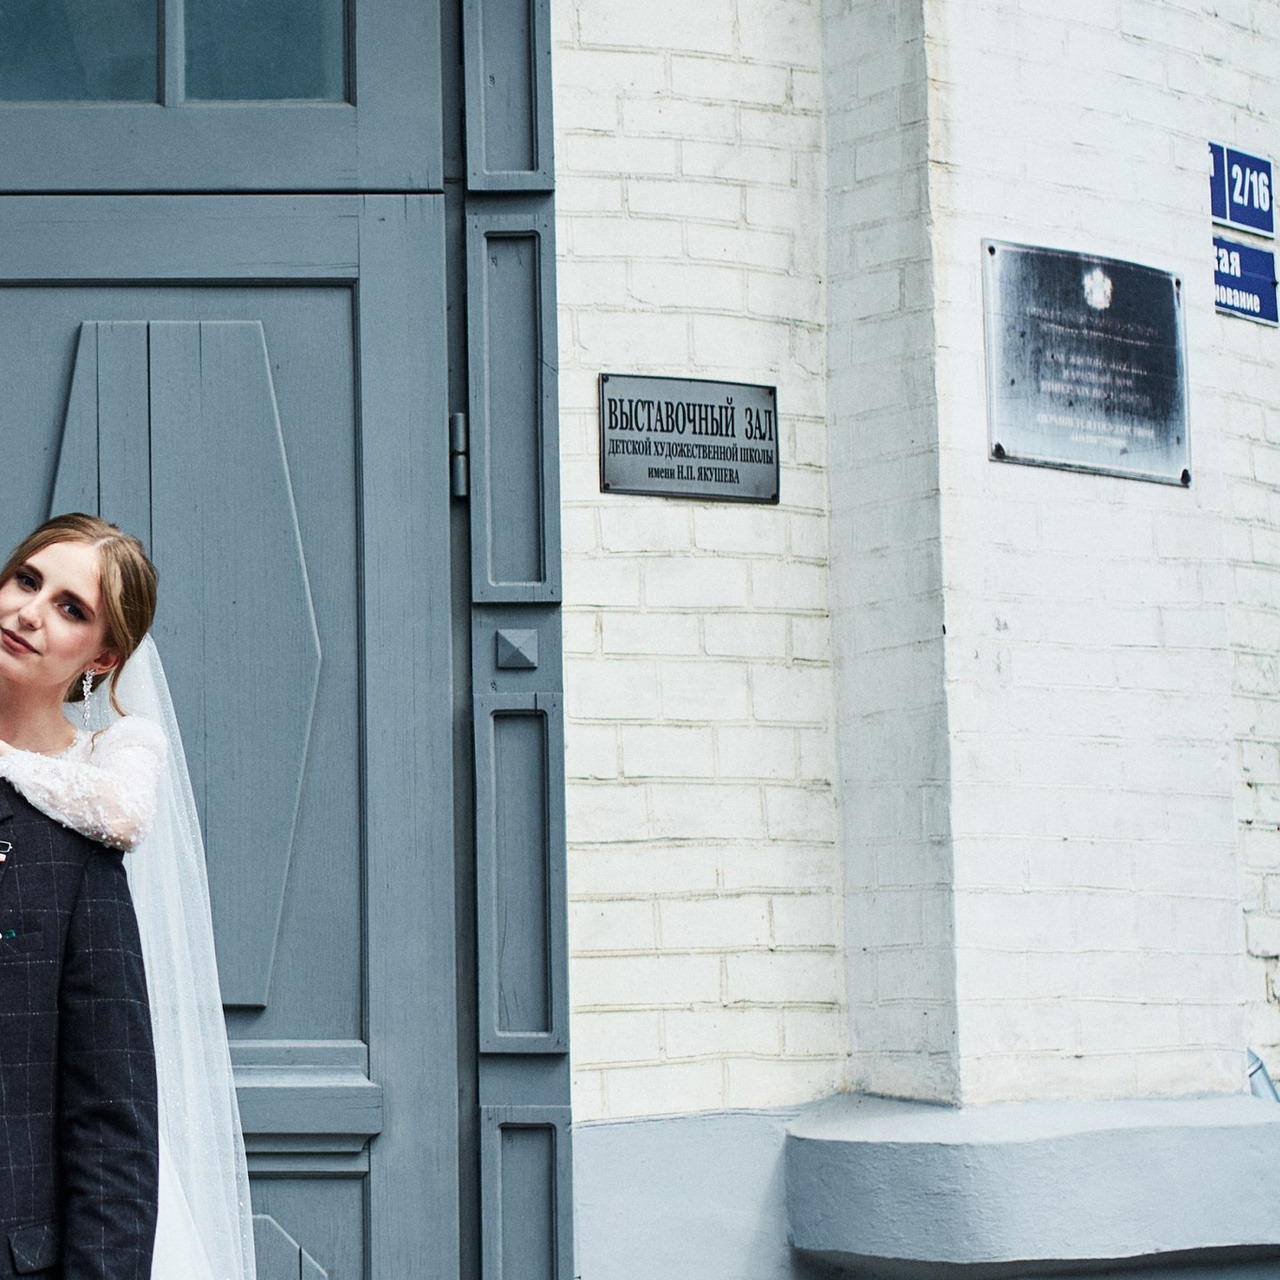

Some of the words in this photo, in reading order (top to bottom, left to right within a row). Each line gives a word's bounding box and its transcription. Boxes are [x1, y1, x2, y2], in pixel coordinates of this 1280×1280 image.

[1231, 163, 1270, 212] 2/16
[607, 397, 736, 438] ВЫСТАВОЧНЫЙ
[745, 407, 773, 441] ЗАЛ
[608, 437, 652, 457] ДЕТСКОЙ
[653, 440, 739, 462] ХУДОЖЕСТВЕННОЙ
[740, 447, 774, 465] ШКОЛЫ
[647, 466, 676, 480] имени
[677, 465, 696, 481] Н.П.
[697, 468, 740, 484] ЯКУШЕВА
